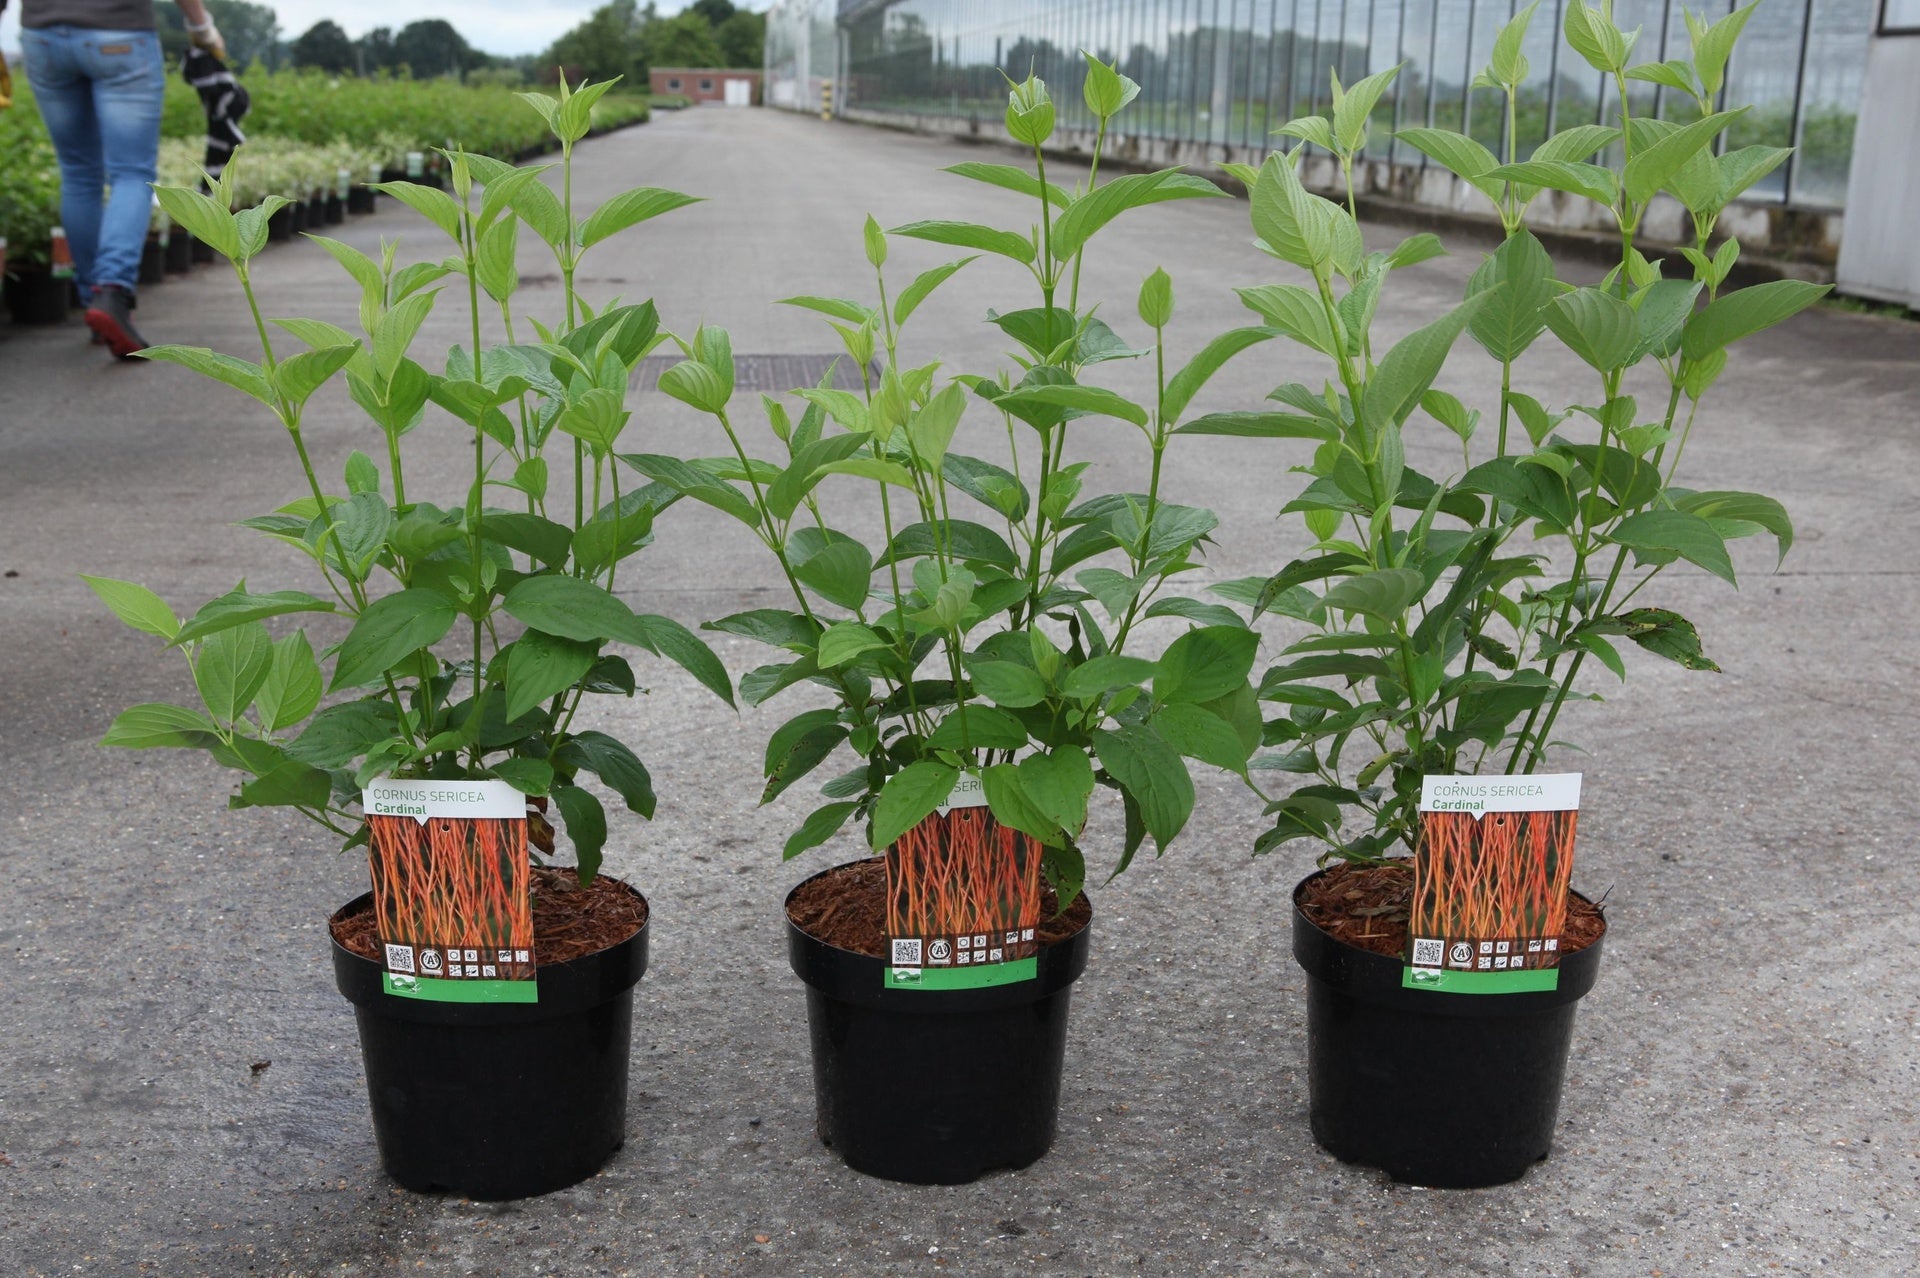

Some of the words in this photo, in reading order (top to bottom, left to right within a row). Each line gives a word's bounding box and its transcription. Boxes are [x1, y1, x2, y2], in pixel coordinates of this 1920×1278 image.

[953, 780, 982, 792] SERI
[1433, 785, 1487, 797] CORNUS
[1490, 785, 1543, 797] SERICEA
[373, 788, 426, 801] CORNUS
[430, 791, 485, 802] SERICEA
[374, 802, 427, 815] Cardinal
[1432, 799, 1484, 810] Cardinal
